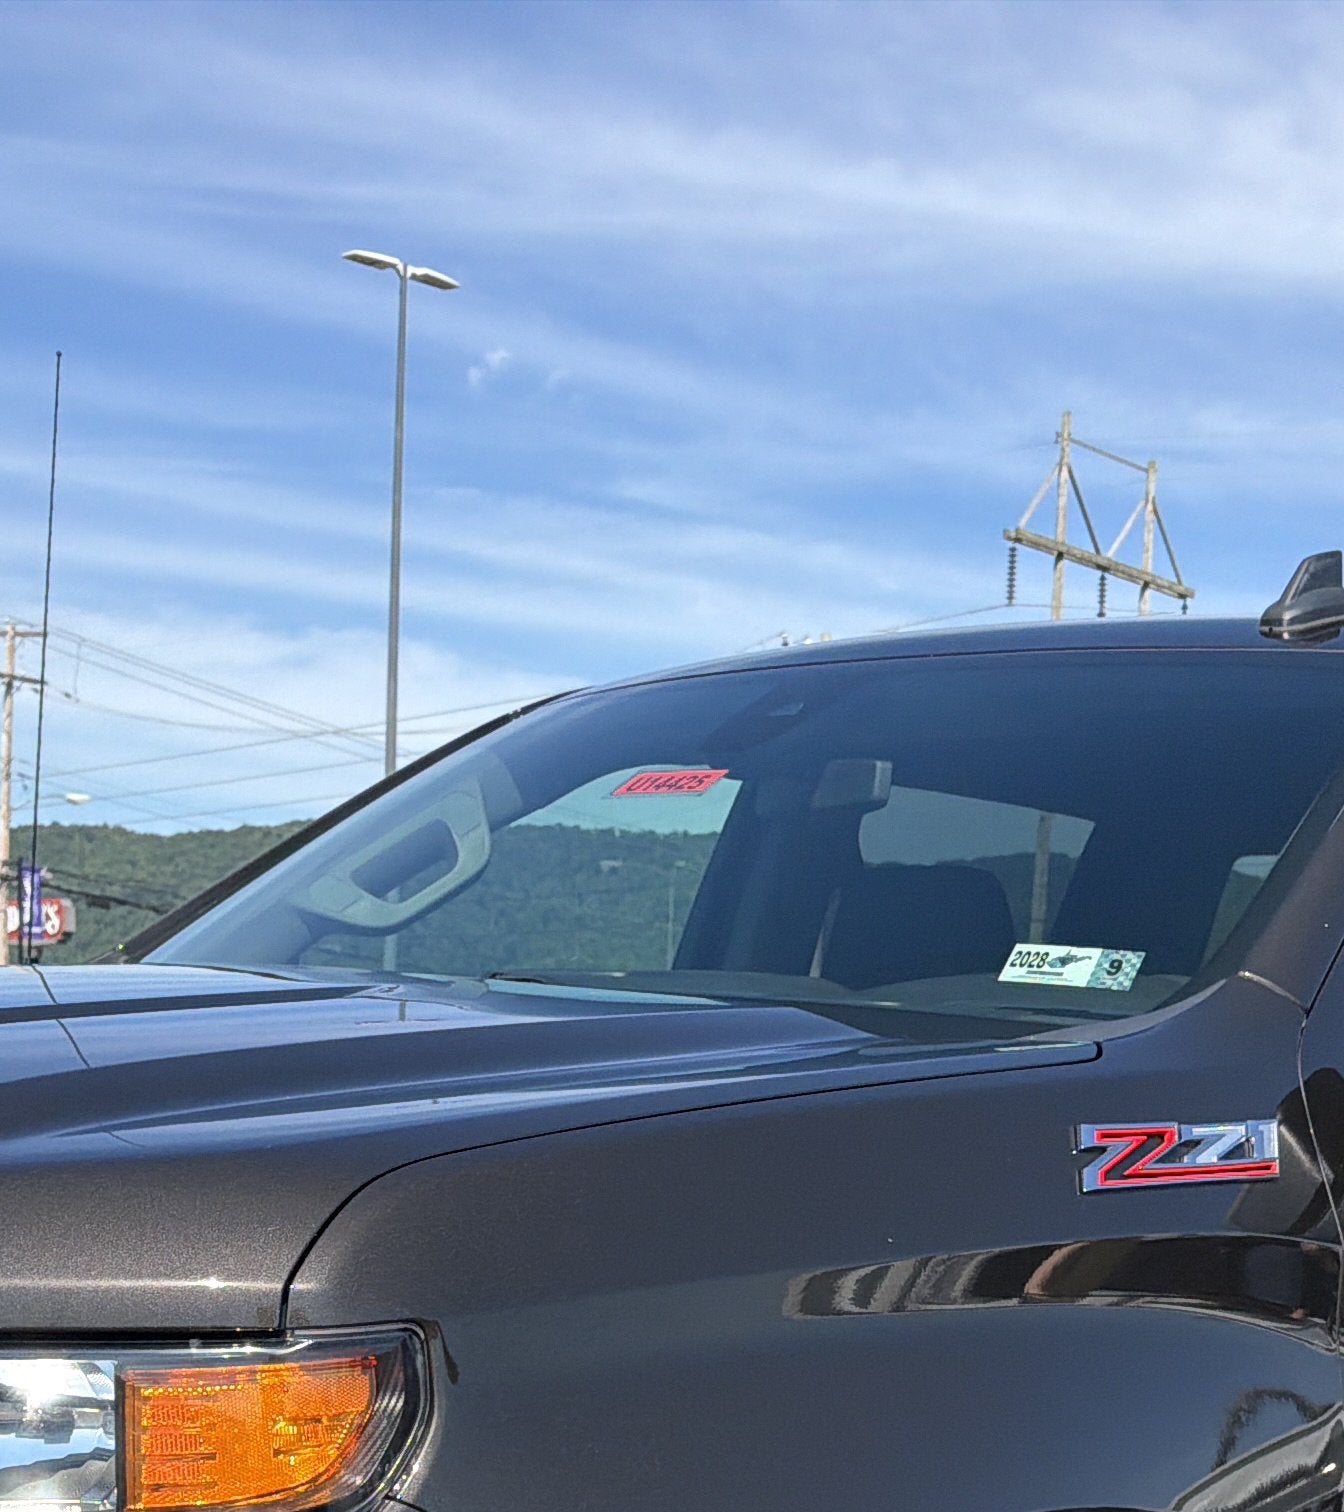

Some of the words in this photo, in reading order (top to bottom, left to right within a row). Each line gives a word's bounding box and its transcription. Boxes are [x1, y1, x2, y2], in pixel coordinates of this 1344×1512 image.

[626, 774, 712, 792] U14425
[1008, 950, 1050, 969] 2028
[1106, 959, 1124, 977] 9
[1074, 1120, 1279, 1192] Z71
